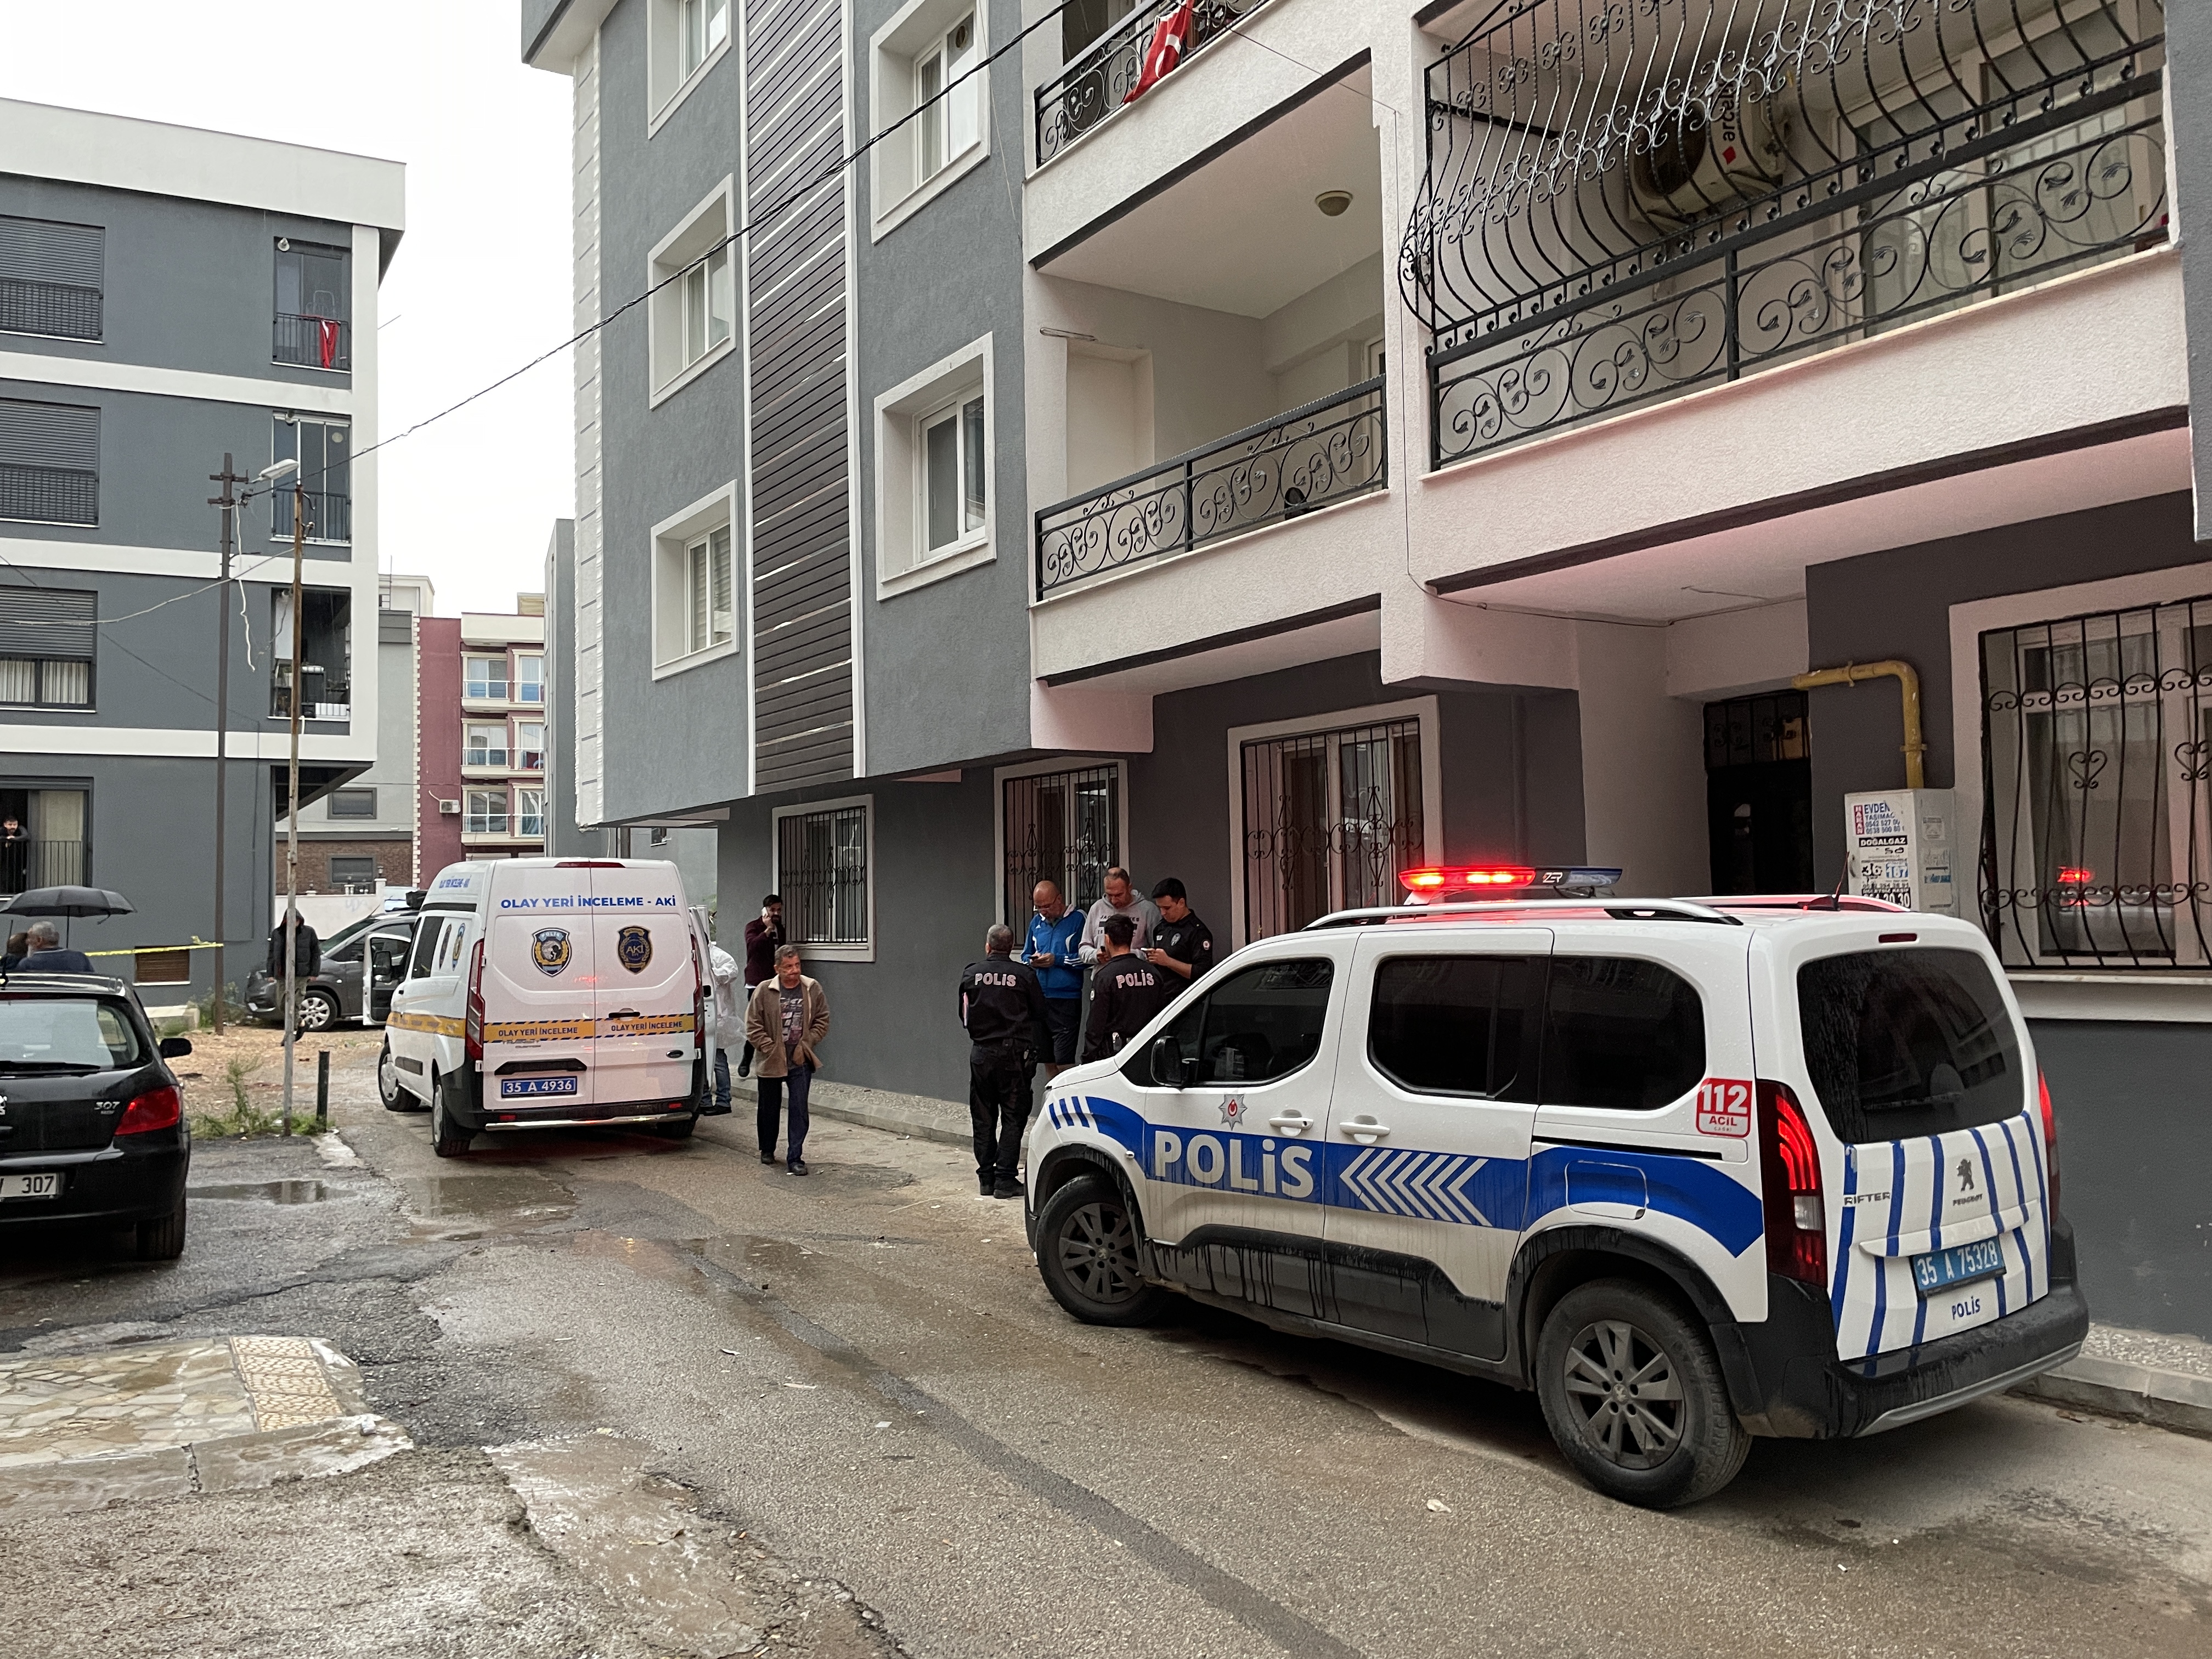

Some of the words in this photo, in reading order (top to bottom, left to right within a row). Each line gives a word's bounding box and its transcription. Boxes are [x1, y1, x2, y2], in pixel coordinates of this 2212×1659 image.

[501, 899, 539, 909] OLAY
[542, 895, 574, 907] YERİ
[578, 895, 644, 907] İNCELEME
[655, 895, 676, 906] AKİ
[520, 1028, 538, 1036] YERİ
[631, 1022, 647, 1030] YERİ
[649, 1021, 682, 1029] İNCELEME
[506, 1082, 521, 1093] 35
[527, 1081, 538, 1092] A
[541, 1080, 572, 1091] 4936
[94, 1101, 120, 1110] 307
[1702, 1084, 1748, 1114] 112
[22, 1176, 54, 1194] 307
[1844, 1192, 1891, 1205] RIFTER
[1918, 1256, 1937, 1286] 35
[1945, 1252, 1955, 1279] A
[1957, 1240, 1998, 1275] 75328
[1951, 1295, 1980, 1320] POLİS
